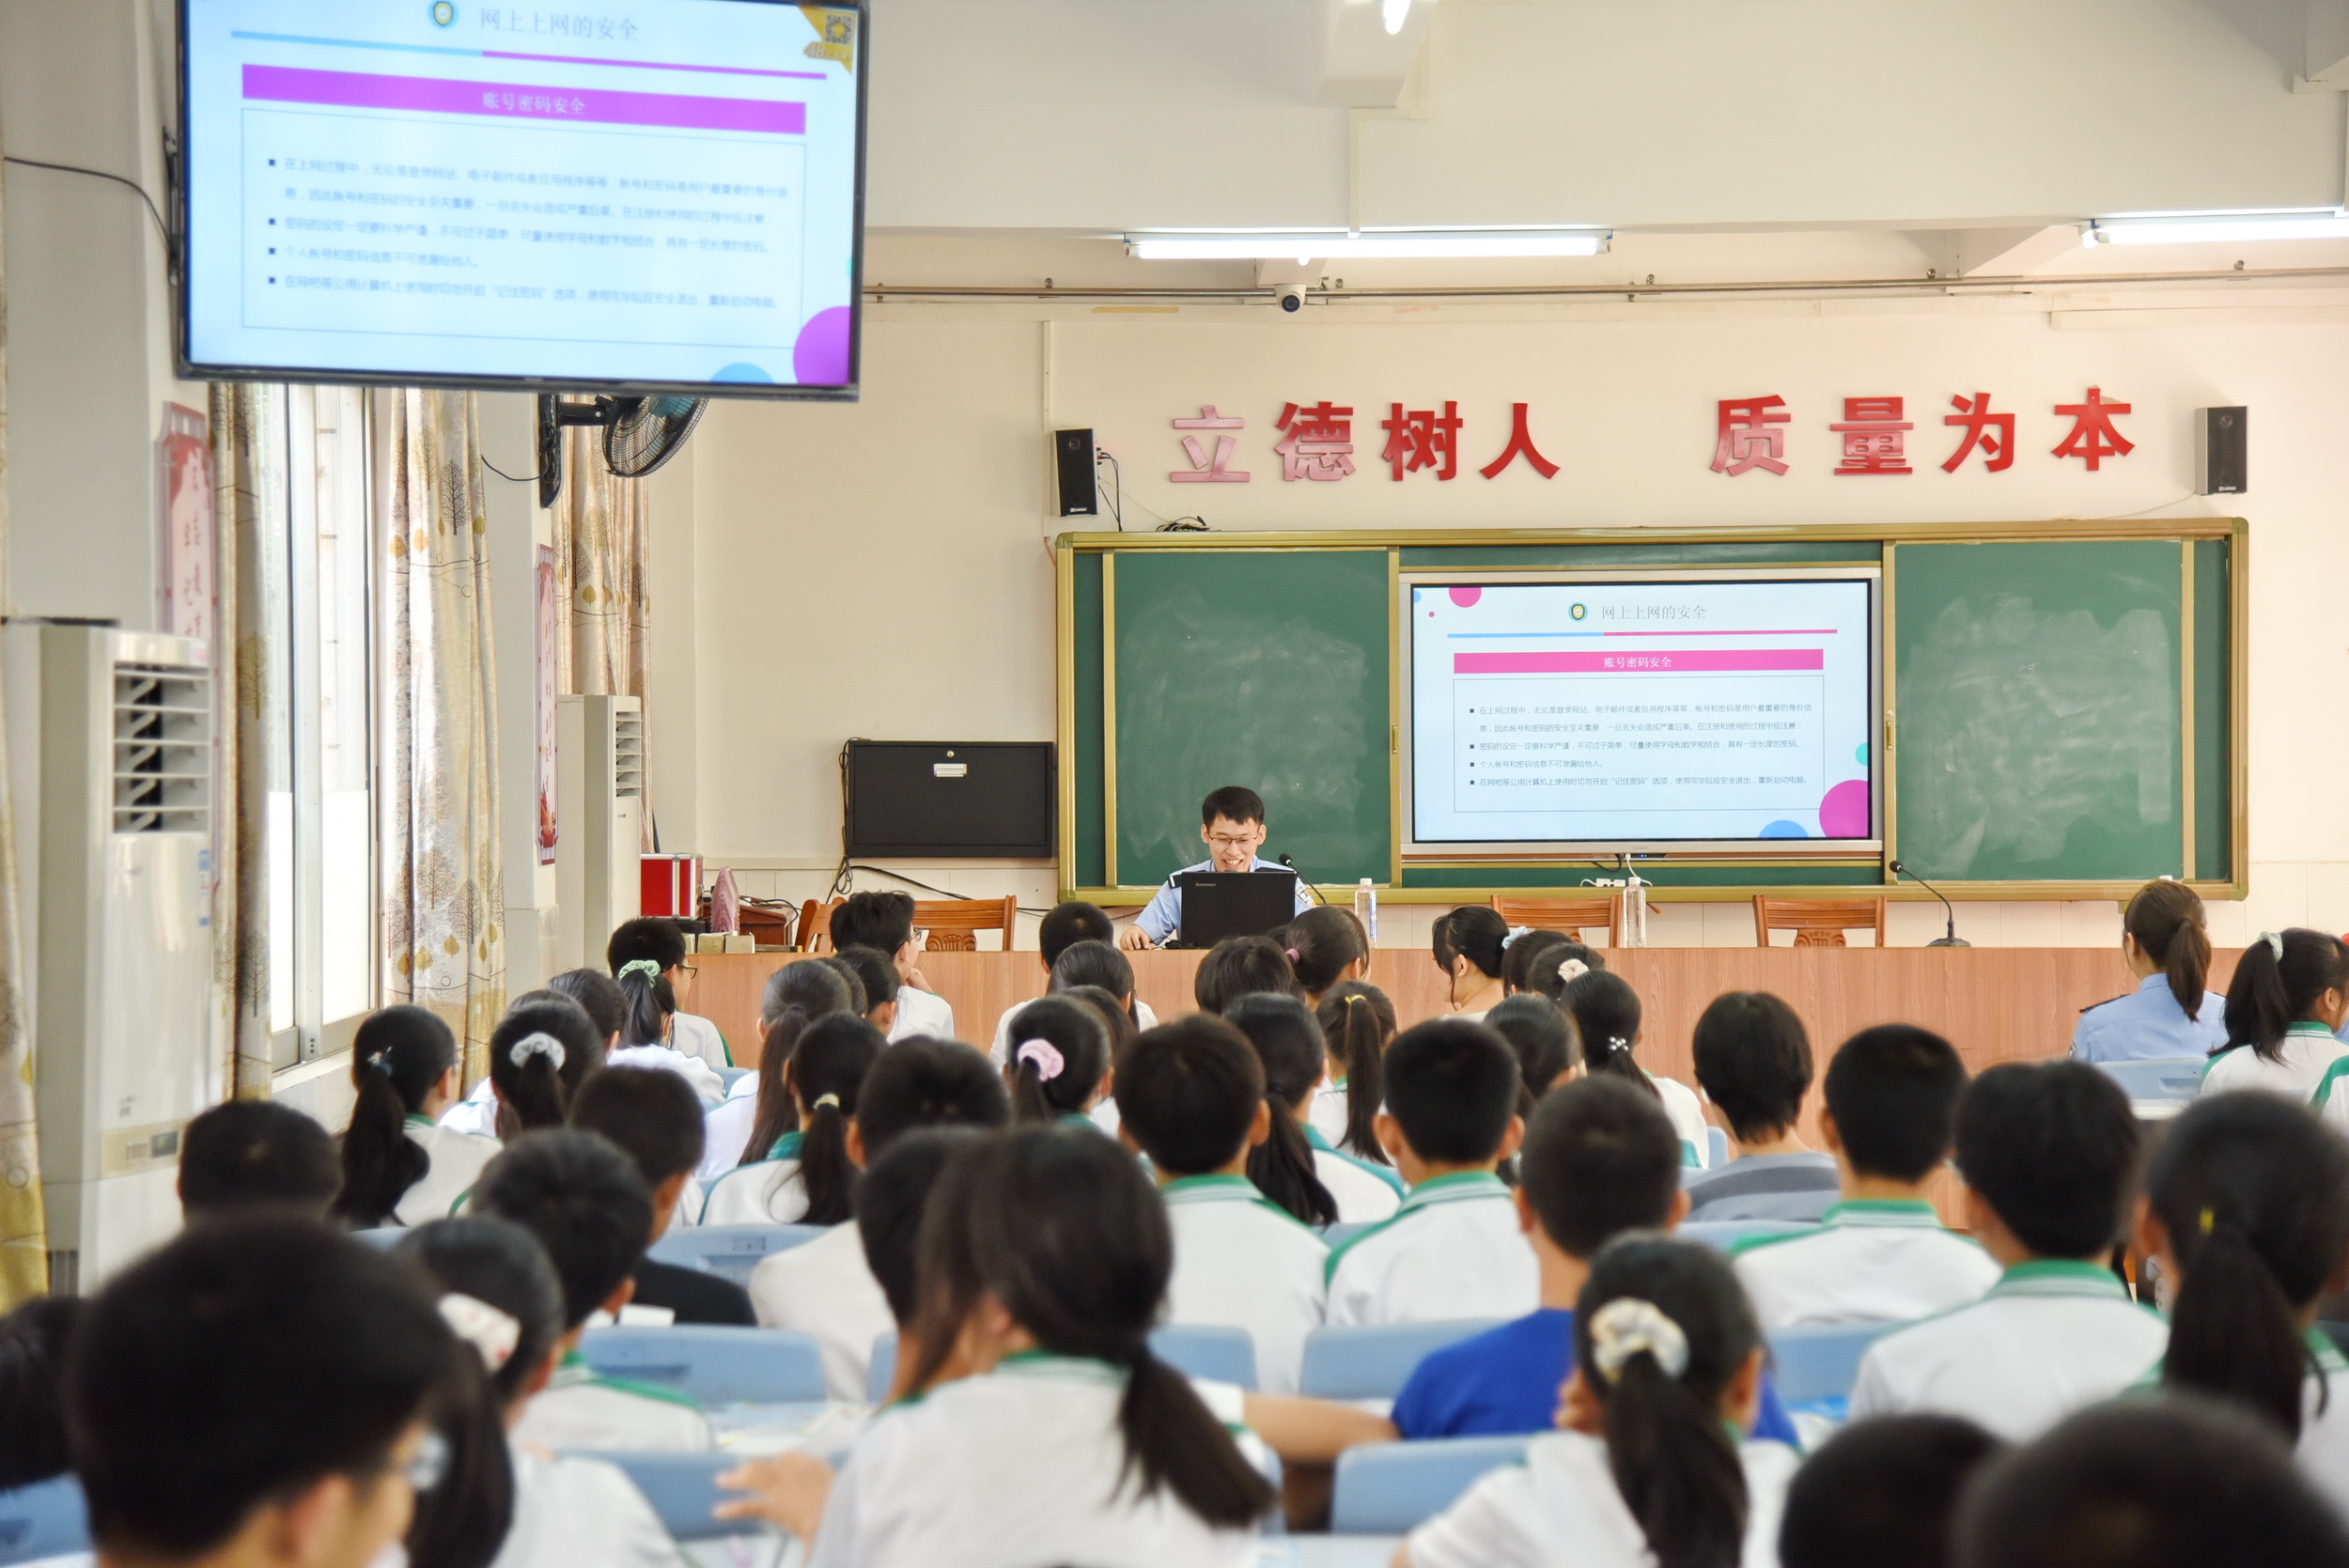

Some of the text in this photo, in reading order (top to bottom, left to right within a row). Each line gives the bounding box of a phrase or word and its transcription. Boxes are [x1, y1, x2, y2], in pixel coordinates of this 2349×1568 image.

[480, 7, 640, 42] 网上上网的安全
[482, 91, 586, 116] 账号密码安全
[1169, 385, 2135, 485] 立德树人 质量为本
[1601, 604, 1707, 620] 网上上网的安全
[1603, 656, 1672, 668] 账号密码安全
